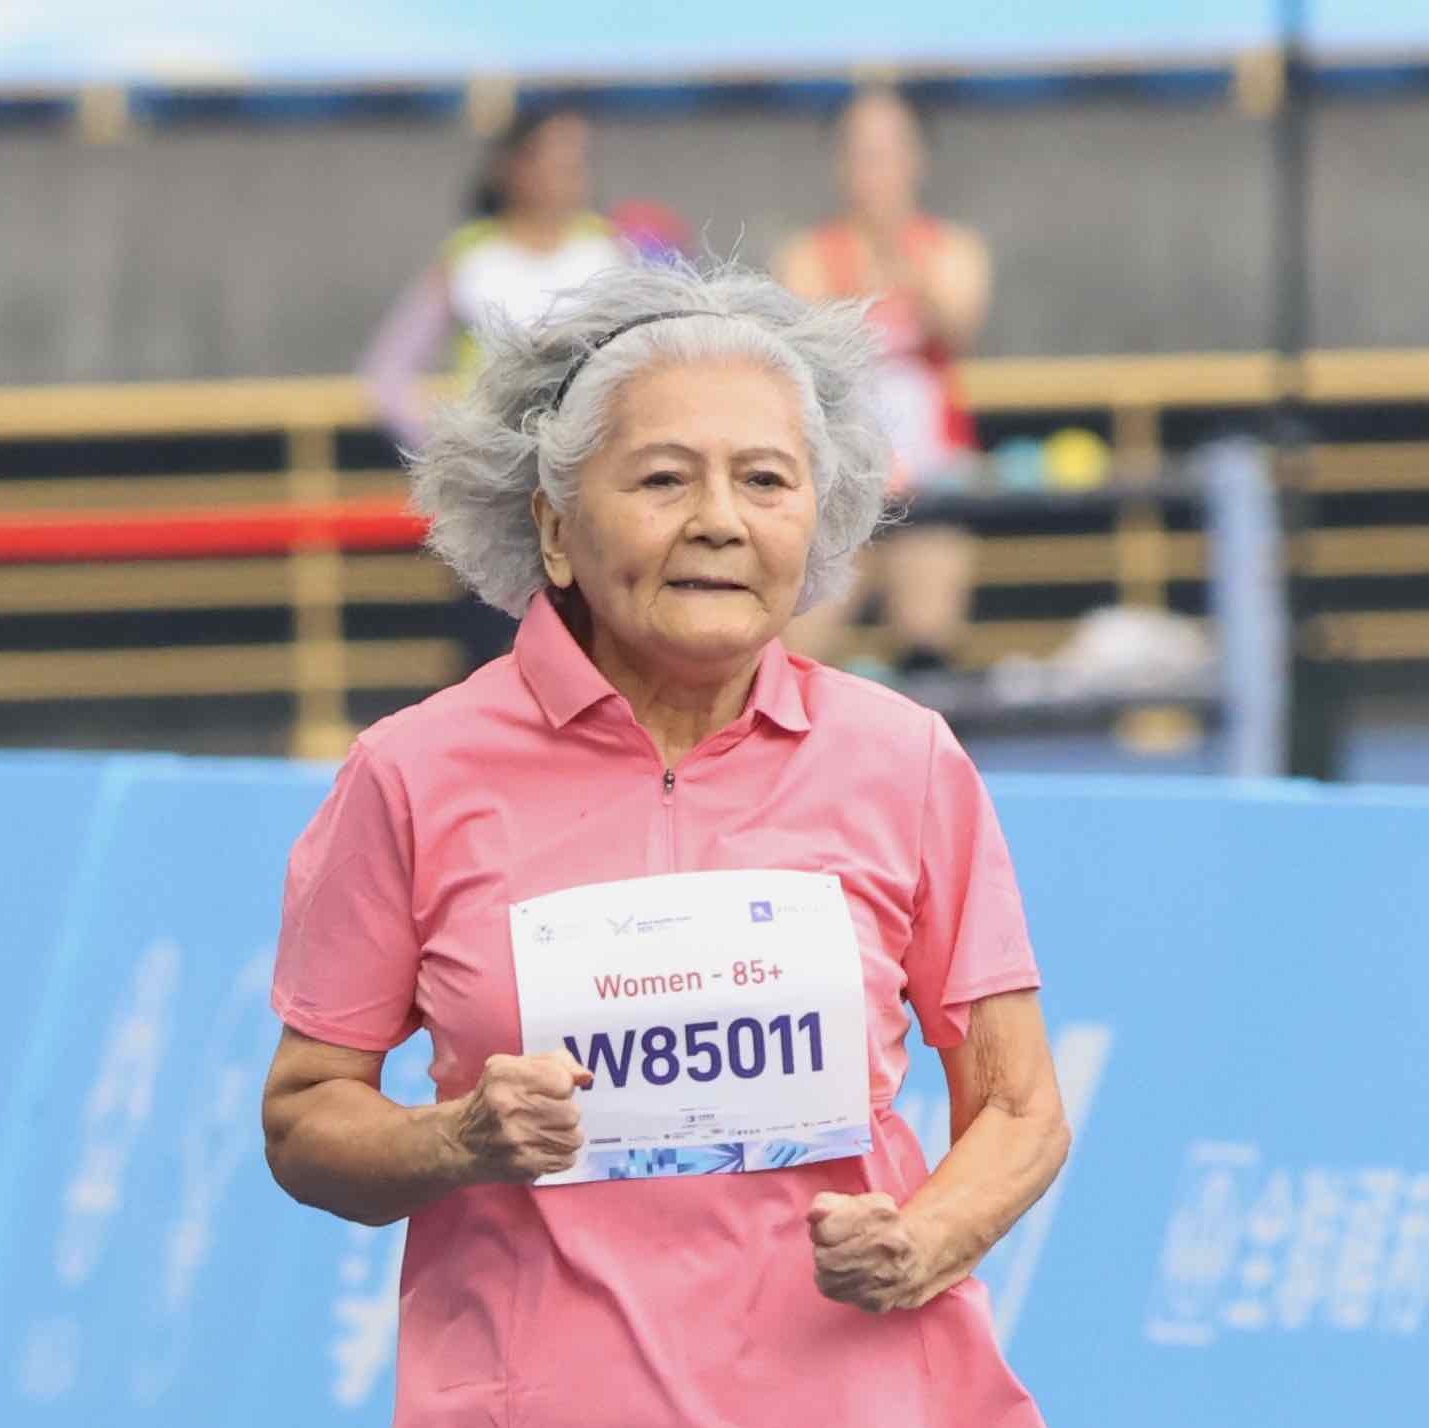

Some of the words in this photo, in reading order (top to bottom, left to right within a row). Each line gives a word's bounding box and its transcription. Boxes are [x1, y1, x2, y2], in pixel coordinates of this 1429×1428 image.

[595, 970, 703, 1000] Women
[732, 959, 783, 987] 85+
[564, 1011, 824, 1091] W85011
